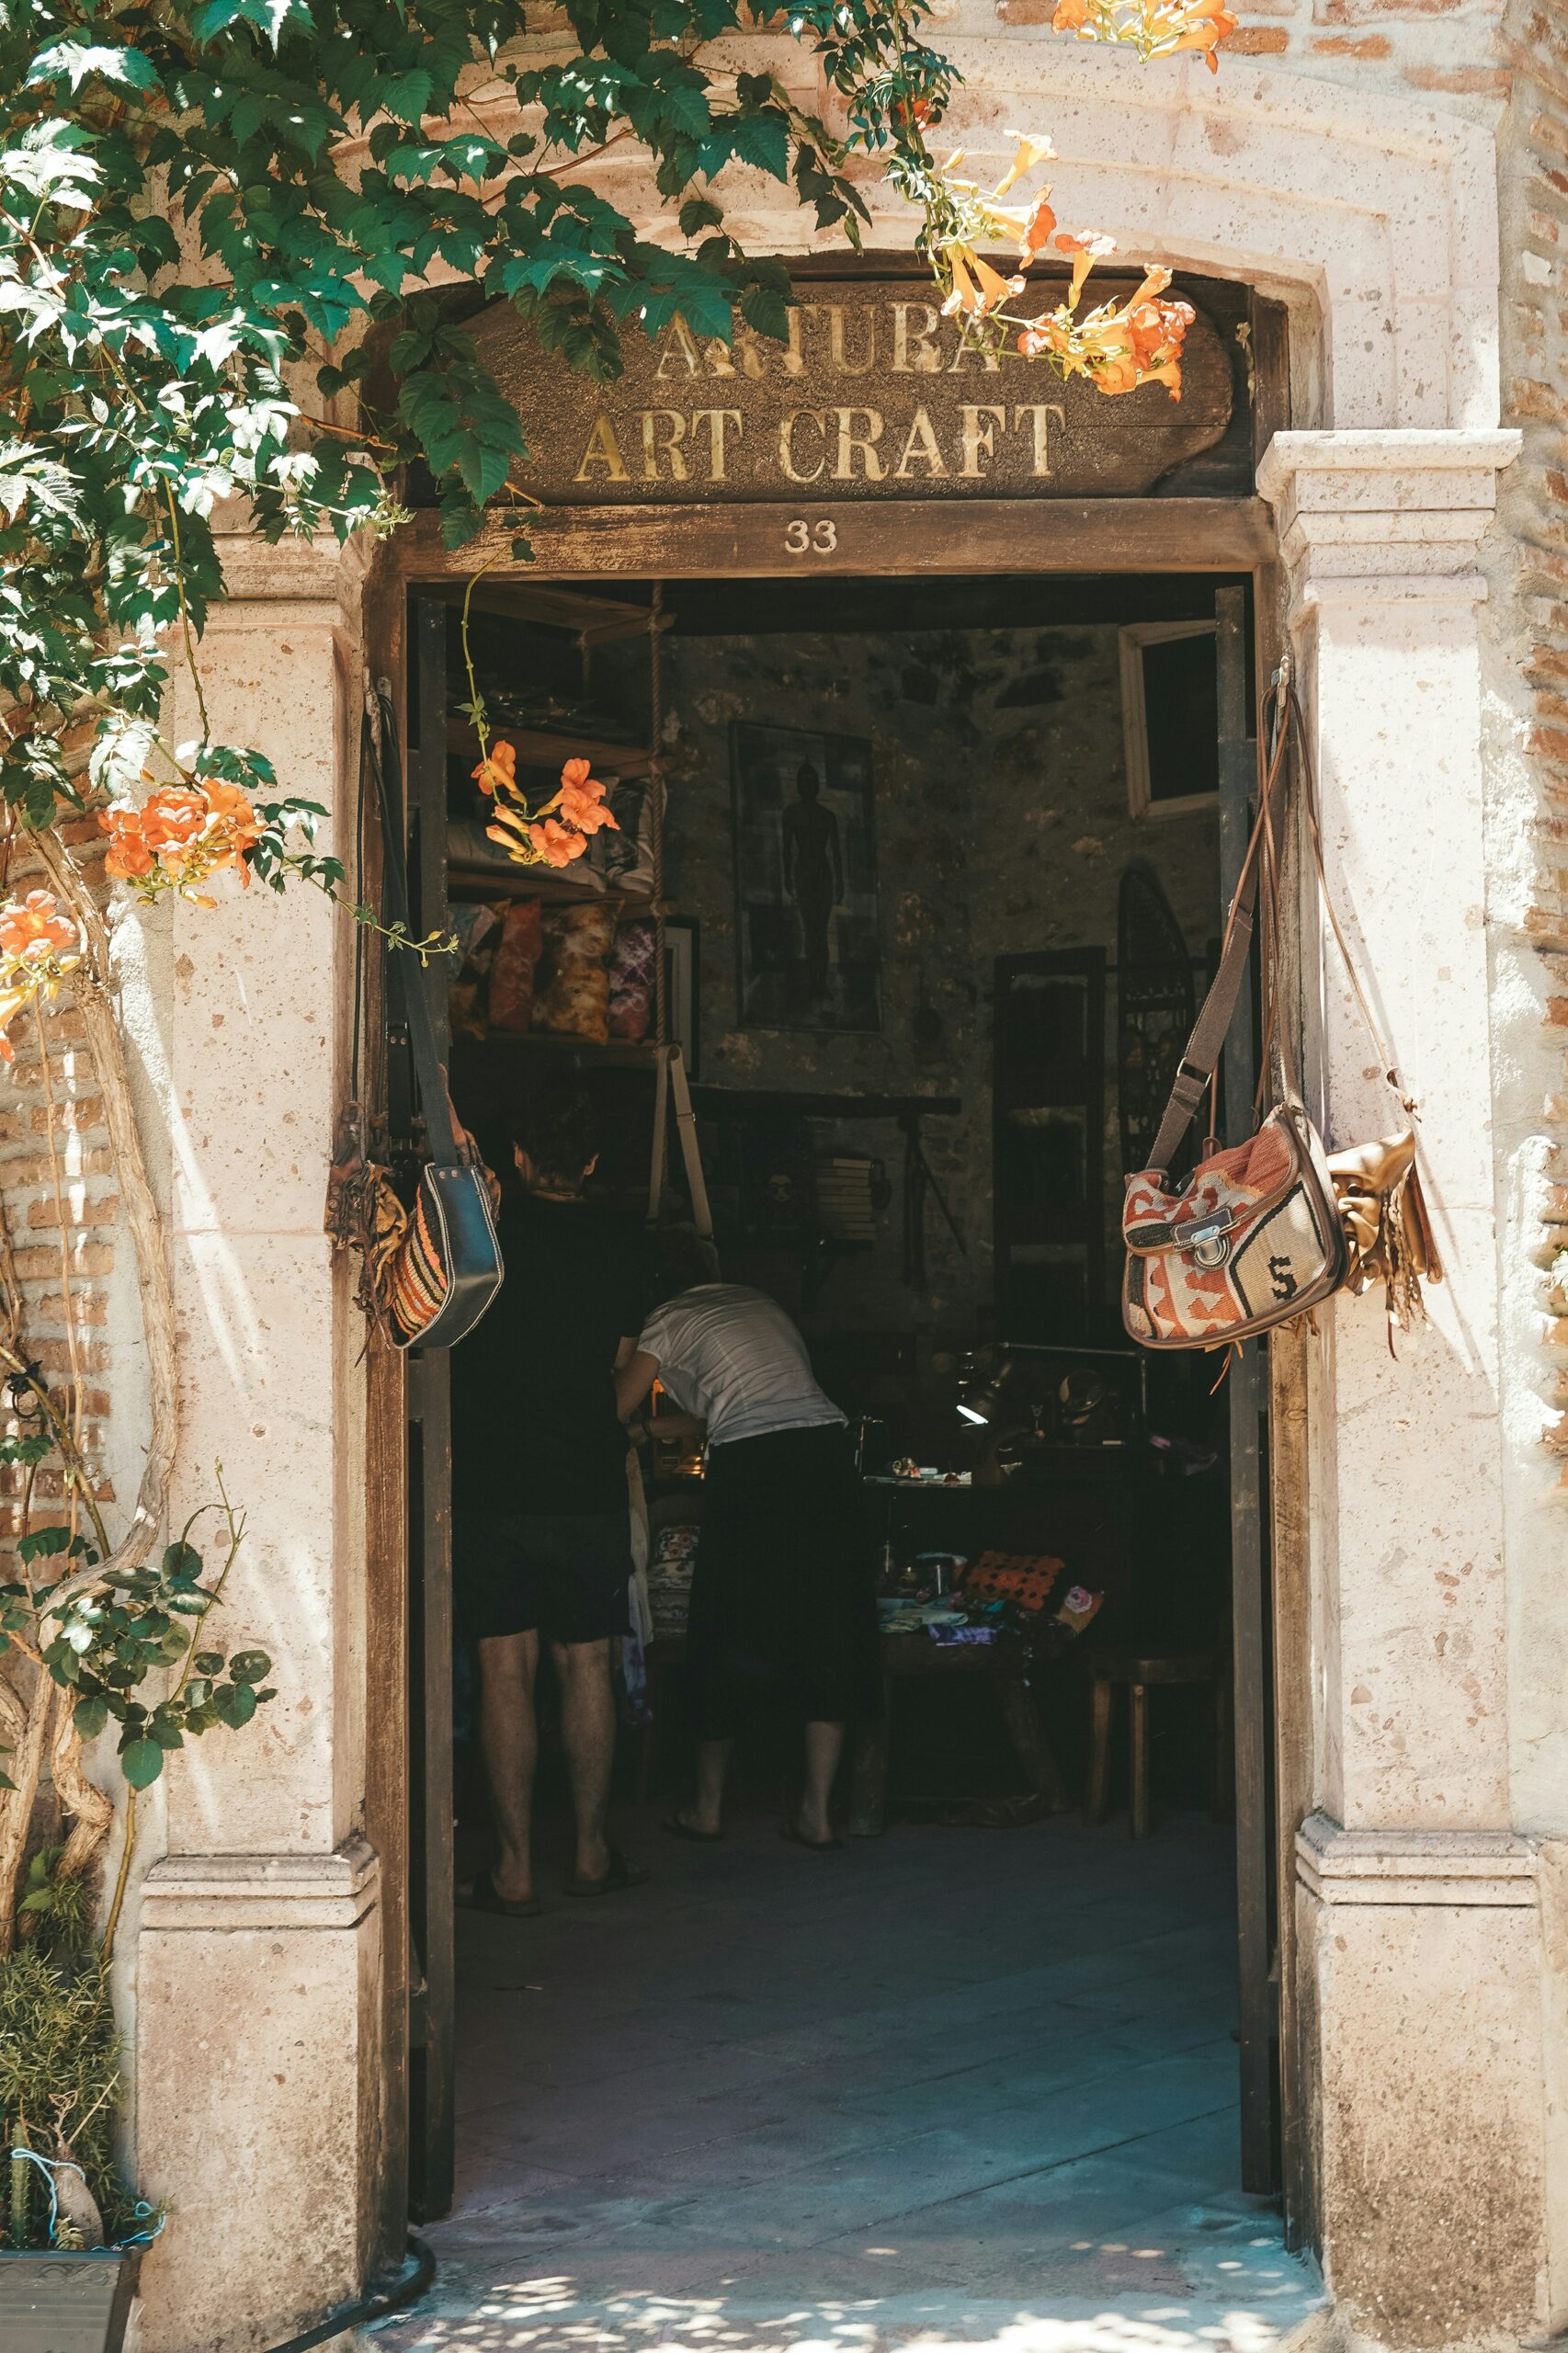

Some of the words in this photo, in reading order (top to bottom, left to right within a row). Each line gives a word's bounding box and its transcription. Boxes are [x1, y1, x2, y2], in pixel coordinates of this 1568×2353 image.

[574, 409, 743, 483] ART
[778, 404, 1065, 483] CRAFT
[785, 519, 838, 555] 33
